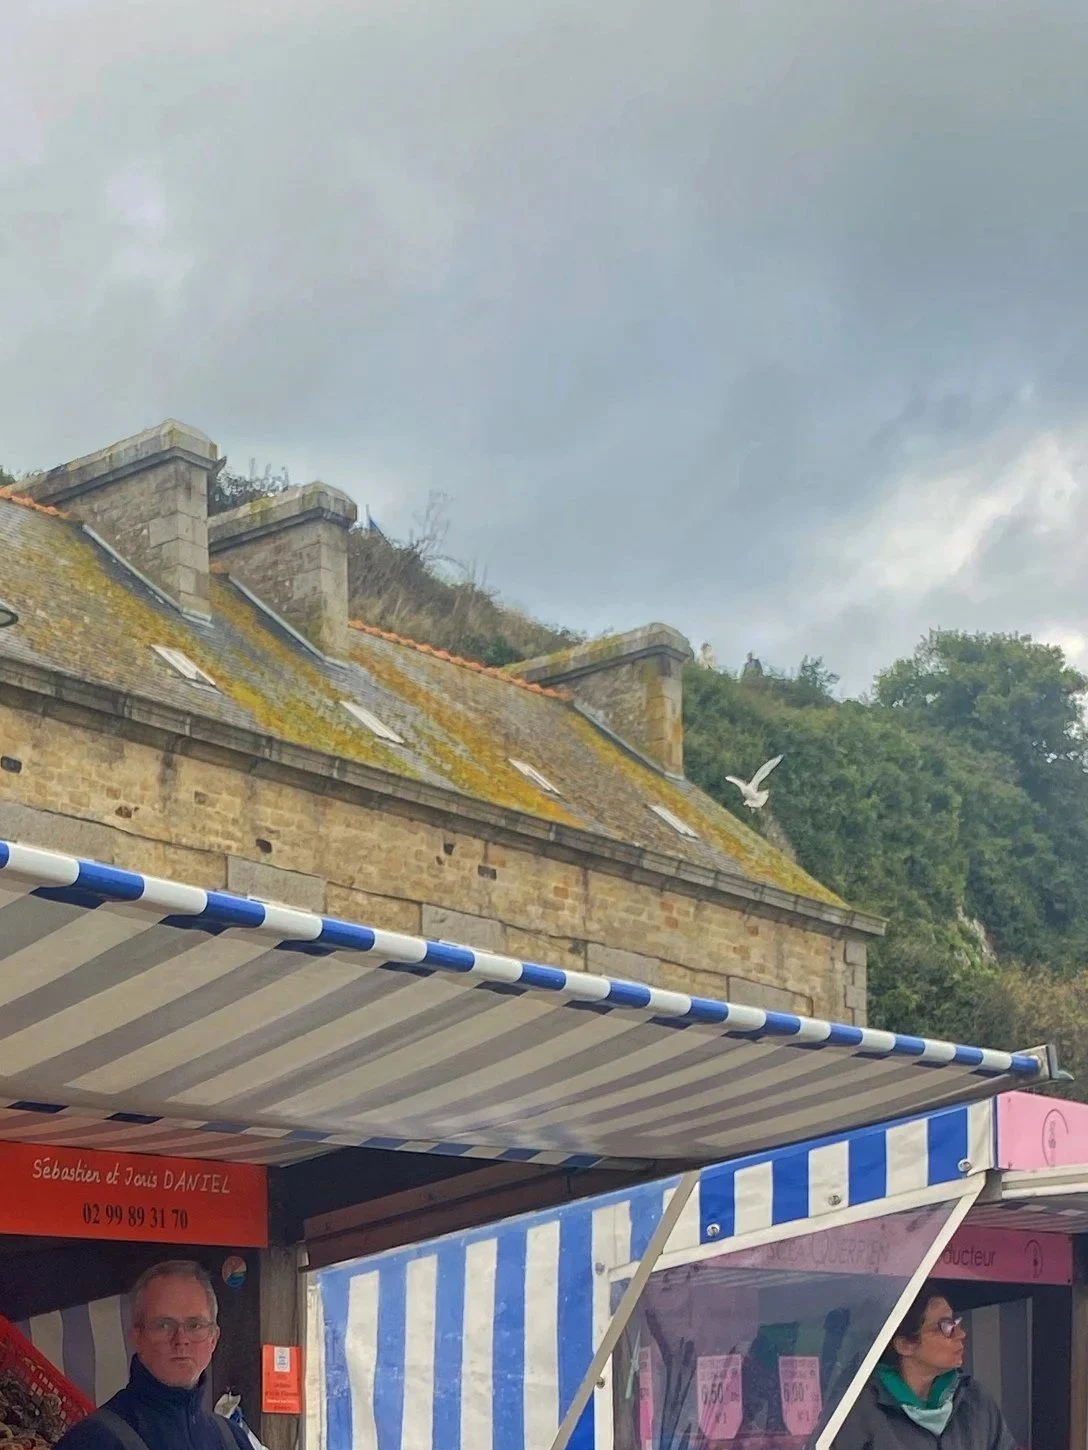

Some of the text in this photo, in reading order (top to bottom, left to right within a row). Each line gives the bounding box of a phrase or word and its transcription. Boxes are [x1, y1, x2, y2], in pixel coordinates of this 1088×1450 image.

[32, 1156, 101, 1184] Sébastien
[107, 1162, 120, 1185] et
[163, 1169, 231, 1194] DANIEL
[82, 1203, 189, 1230] 02 99 89 31 70
